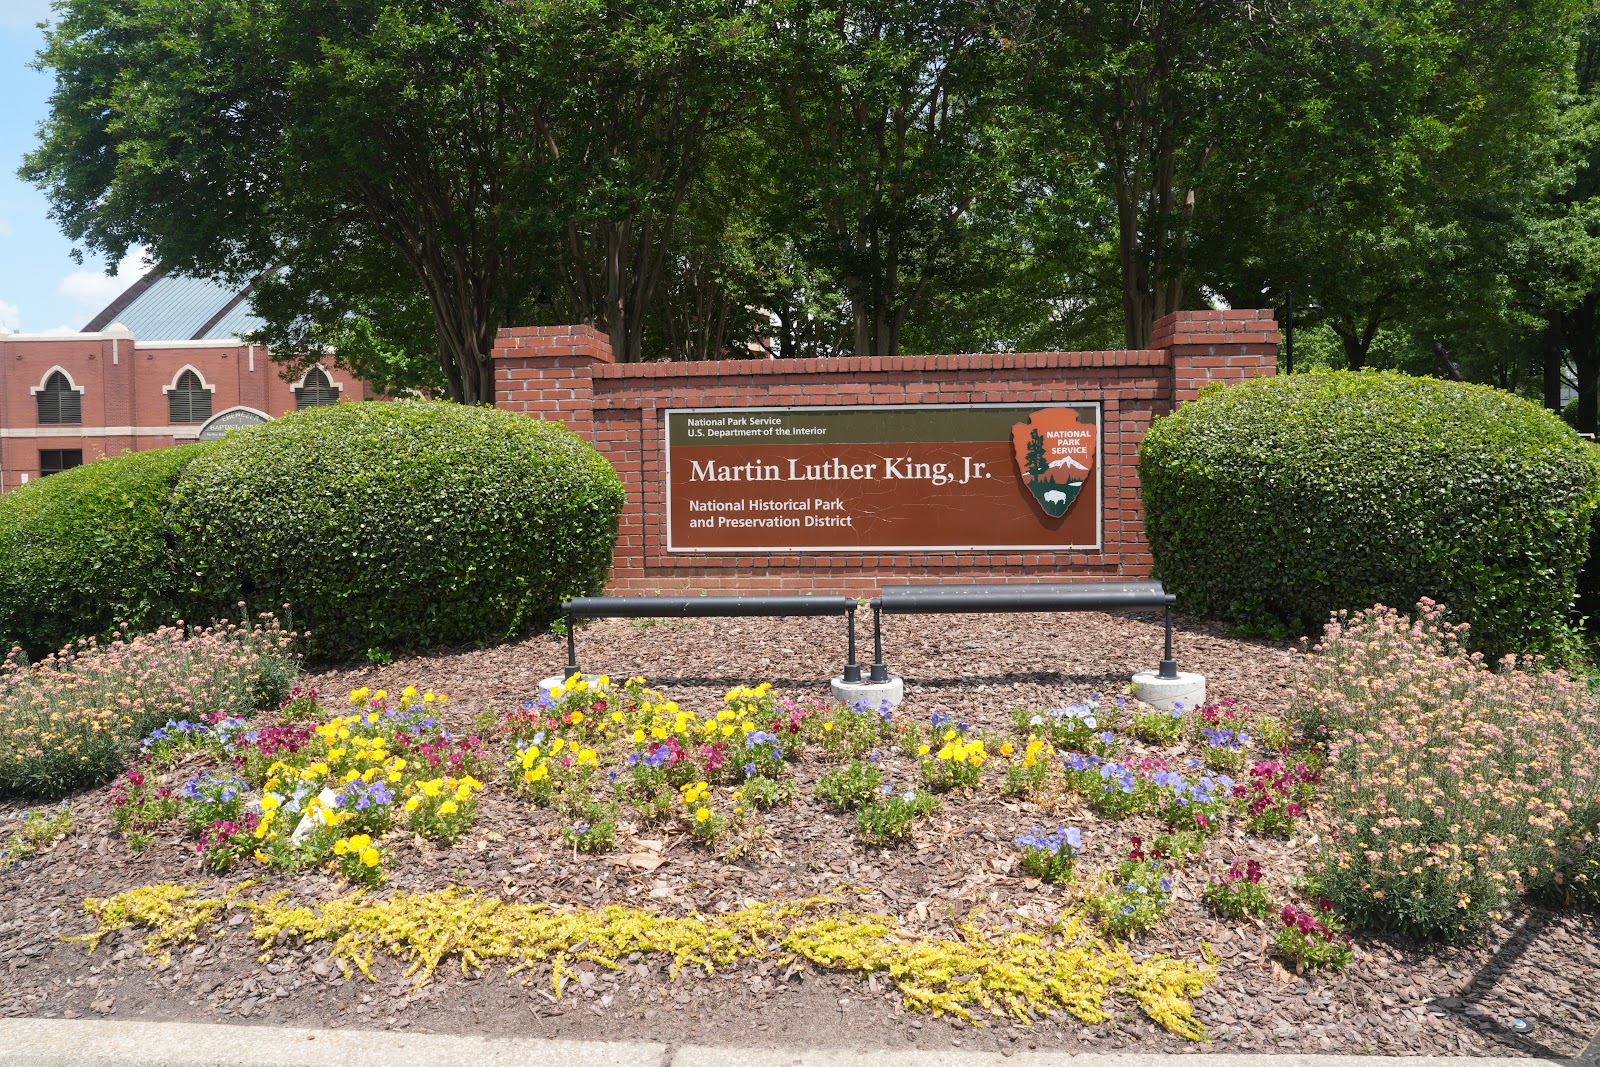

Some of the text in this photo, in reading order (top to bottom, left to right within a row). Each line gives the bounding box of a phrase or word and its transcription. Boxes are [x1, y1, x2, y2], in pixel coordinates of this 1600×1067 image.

[687, 415, 782, 427] National Park Service
[687, 426, 826, 438] U.S. Department of the Interior
[1046, 430, 1091, 438] NATIONAL
[1052, 446, 1086, 454] SERVICE
[690, 456, 991, 486] Martin Luther King, Jr.
[689, 498, 844, 512] National Historical Park
[689, 515, 852, 528] and Preservation District
